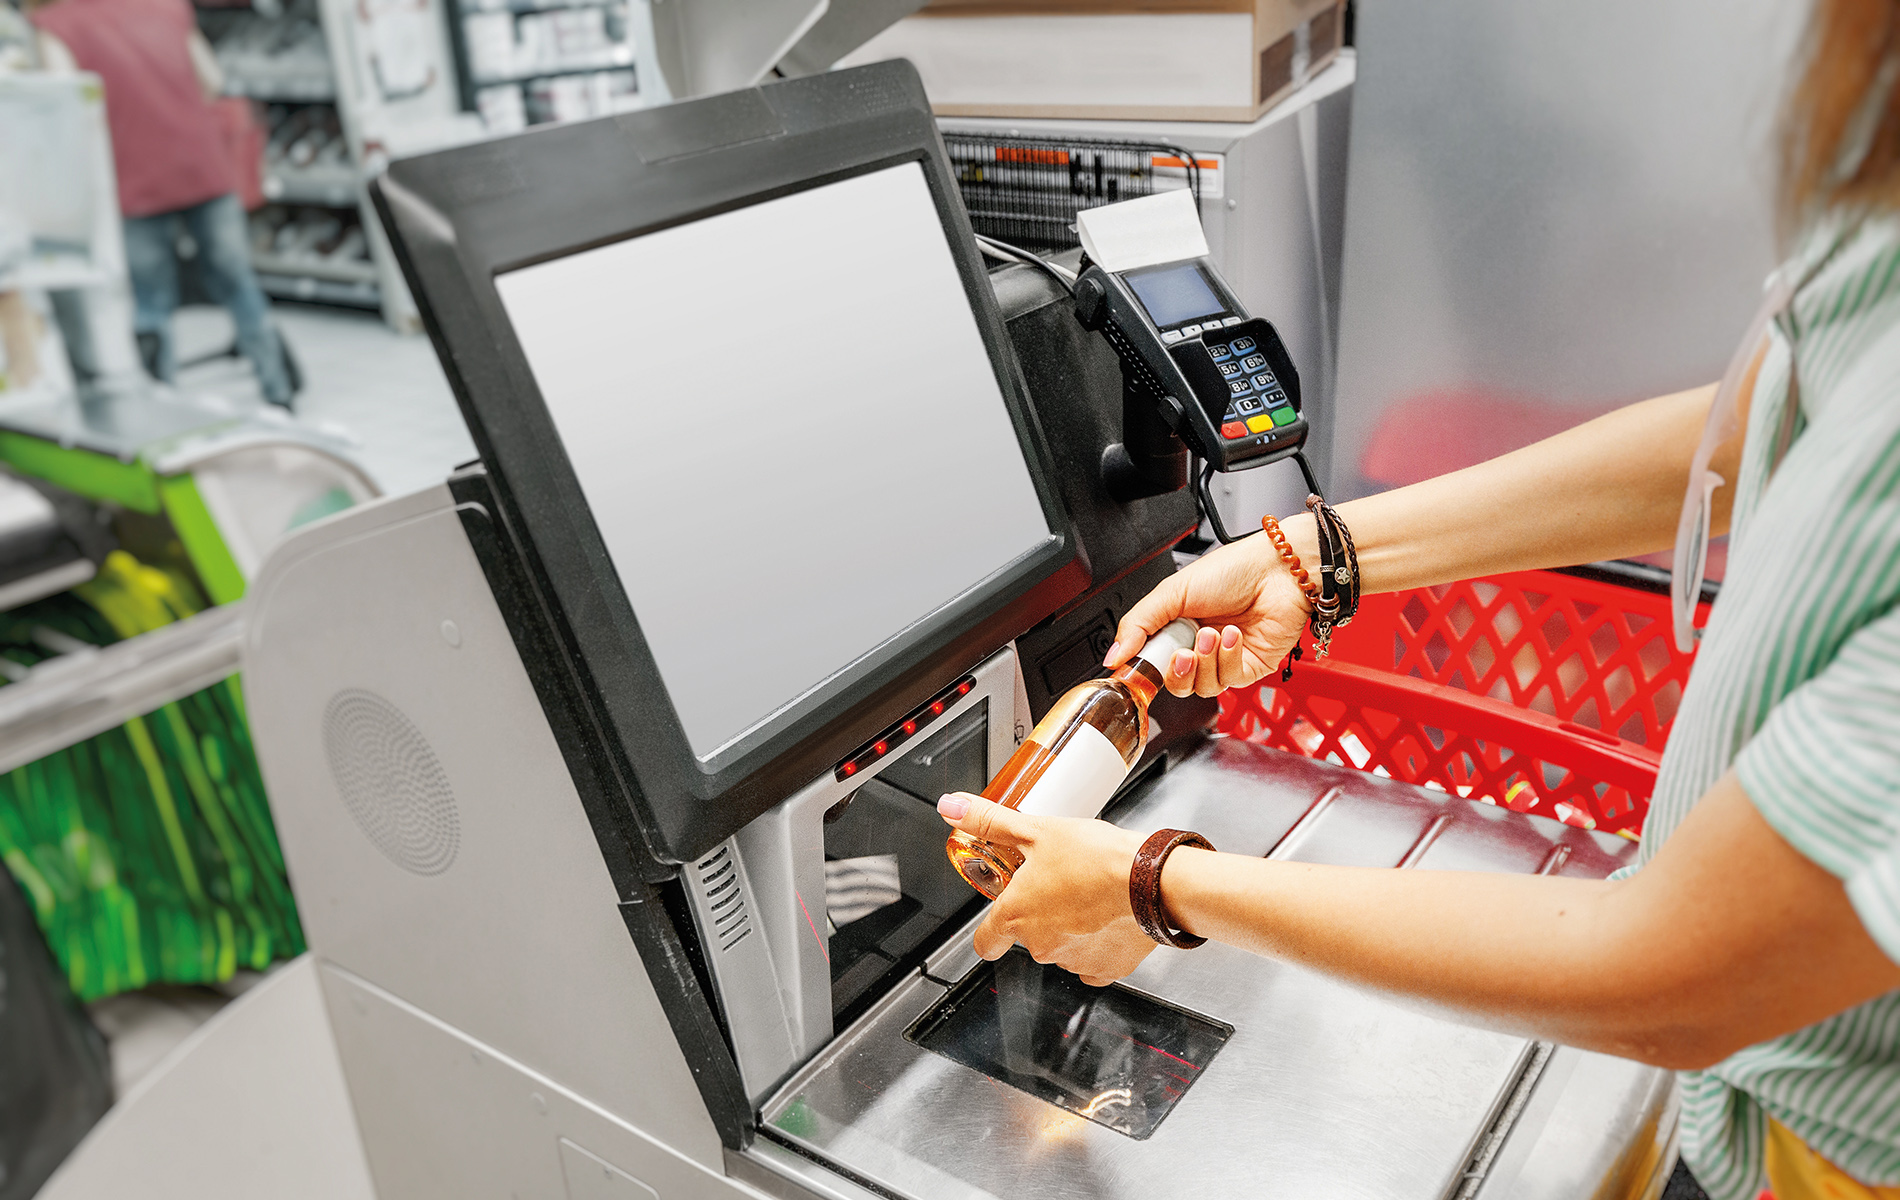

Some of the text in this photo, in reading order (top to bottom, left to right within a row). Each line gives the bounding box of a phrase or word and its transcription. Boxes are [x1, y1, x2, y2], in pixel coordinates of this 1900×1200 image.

[1237, 340, 1245, 349] 3
[1211, 349, 1220, 357] 2
[1247, 358, 1255, 367] 6
[1220, 365, 1230, 374] 5
[1257, 376, 1266, 384] 9
[1232, 383, 1240, 392] 8
[1243, 401, 1253, 410] 0
